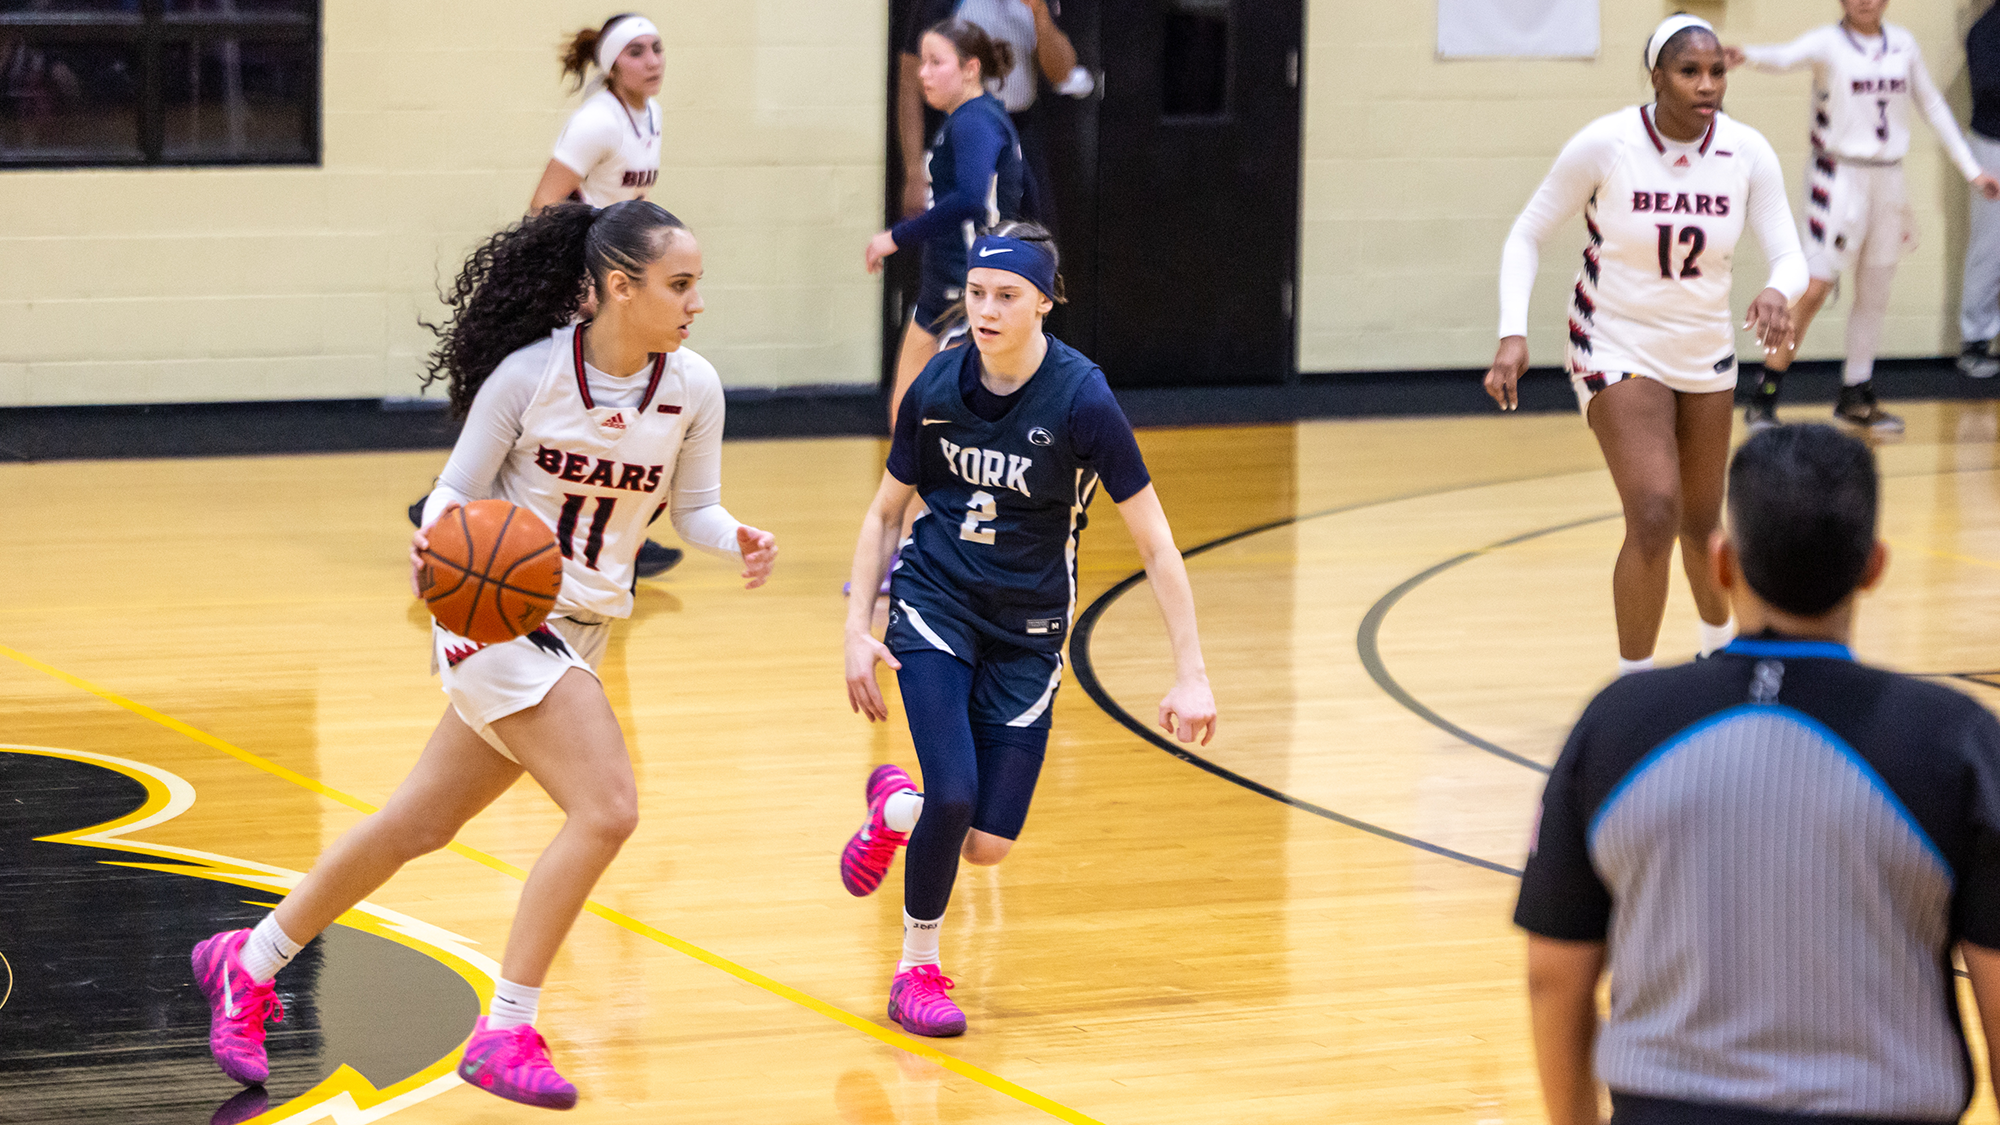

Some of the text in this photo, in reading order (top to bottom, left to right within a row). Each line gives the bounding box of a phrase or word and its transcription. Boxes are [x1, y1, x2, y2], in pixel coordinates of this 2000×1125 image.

[1631, 191, 1731, 218] BEARS
[1655, 223, 1707, 280] 12
[534, 444, 664, 493] BEARS
[939, 436, 1033, 498] YORK
[556, 492, 619, 572] 11
[959, 490, 999, 546] 2
